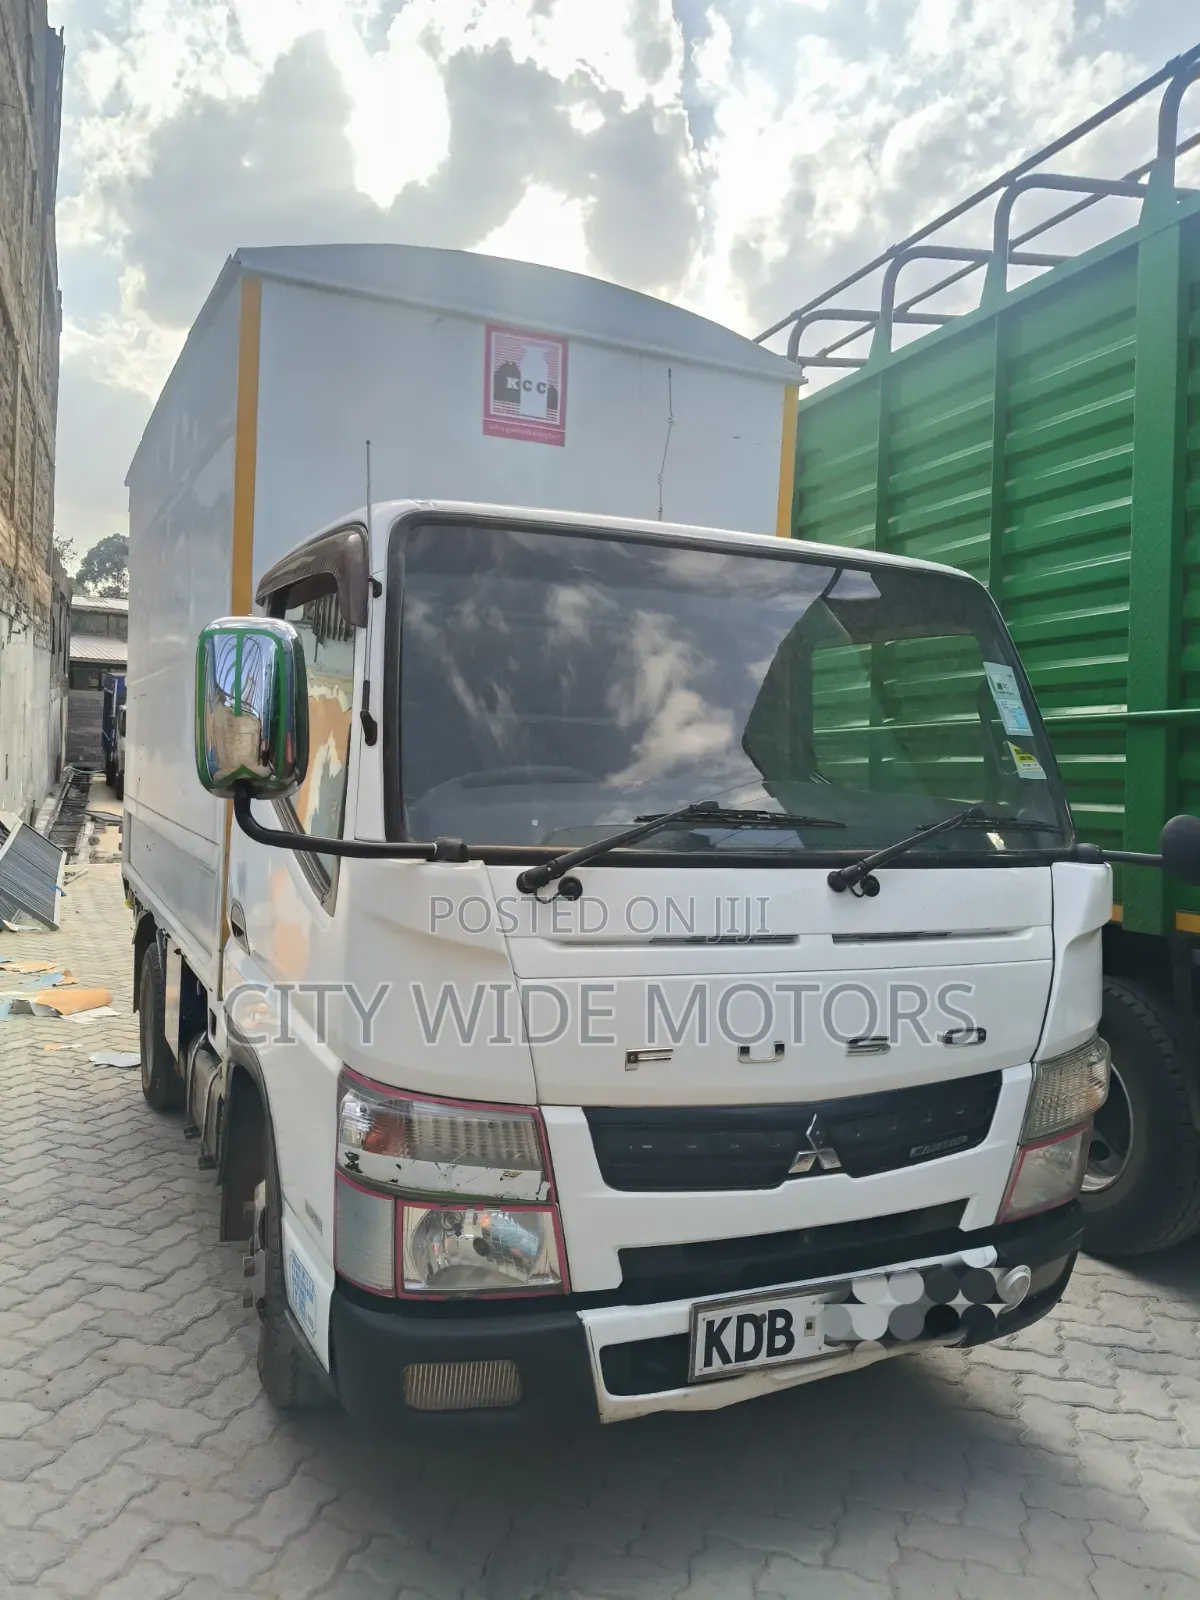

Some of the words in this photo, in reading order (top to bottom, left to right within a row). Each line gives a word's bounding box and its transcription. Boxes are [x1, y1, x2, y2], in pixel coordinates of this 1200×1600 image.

[506, 377, 547, 394] KCC
[624, 1027, 987, 1071] FUSO
[703, 1308, 796, 1368] KDB
